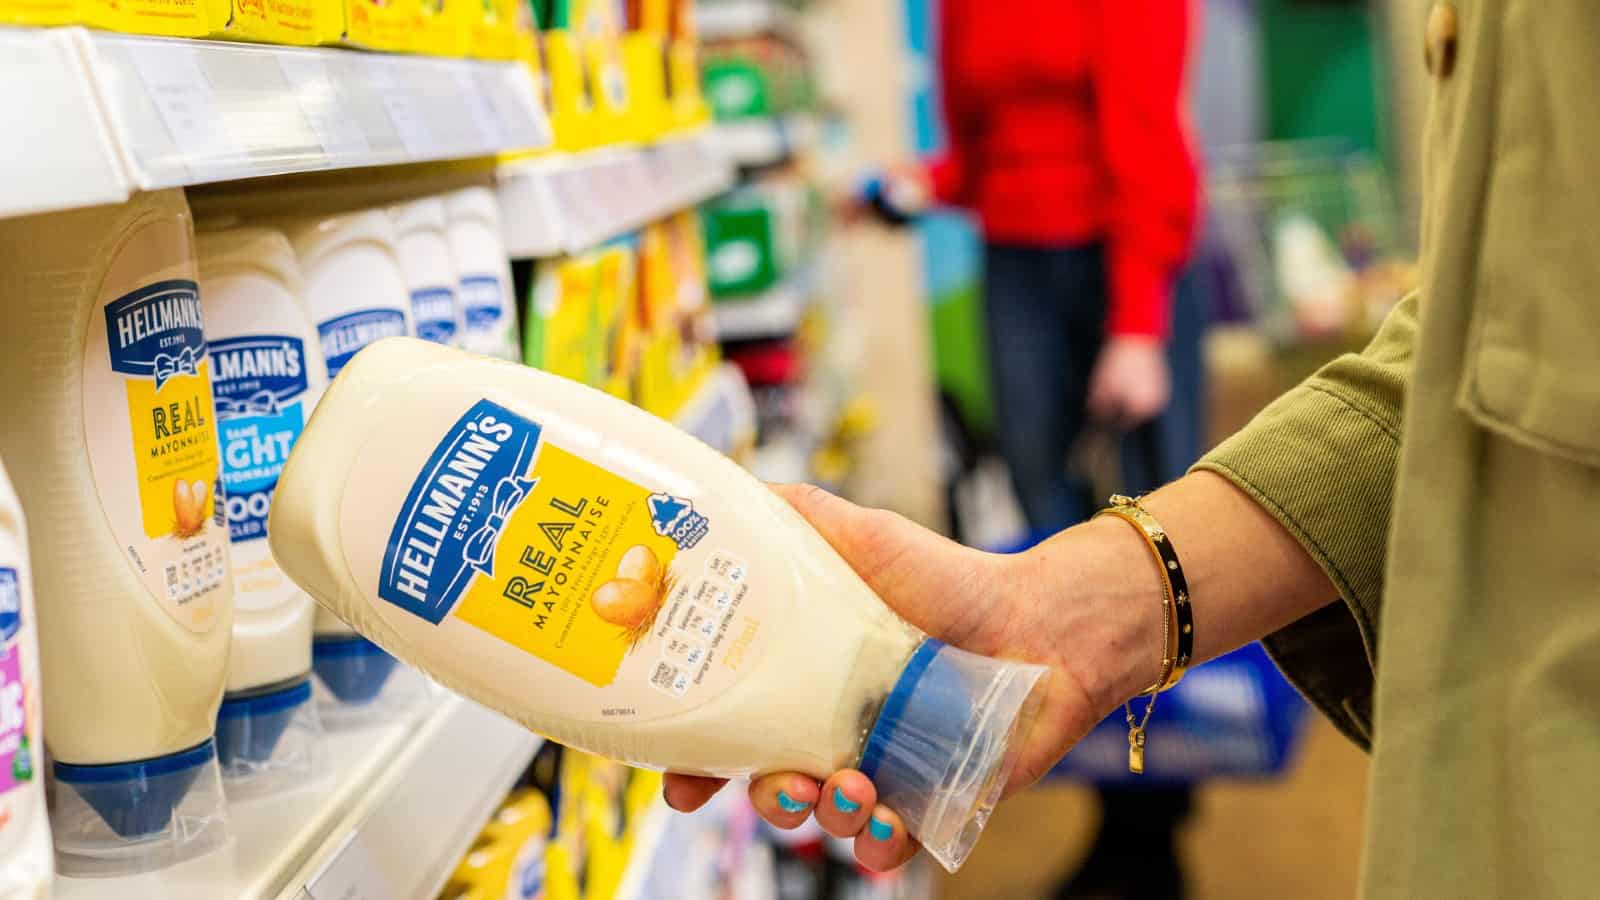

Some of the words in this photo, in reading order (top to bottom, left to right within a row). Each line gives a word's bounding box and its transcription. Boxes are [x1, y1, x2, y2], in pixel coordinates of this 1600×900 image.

[208, 341, 301, 381] LMANN'S
[152, 395, 205, 440] REAL
[225, 430, 294, 469] GHT
[396, 415, 513, 602] HELLMANN'S
[453, 484, 489, 541] EST.1913
[670, 512, 700, 542] 100%
[502, 496, 588, 609] REAL
[533, 495, 610, 630] MAYONNAISE
